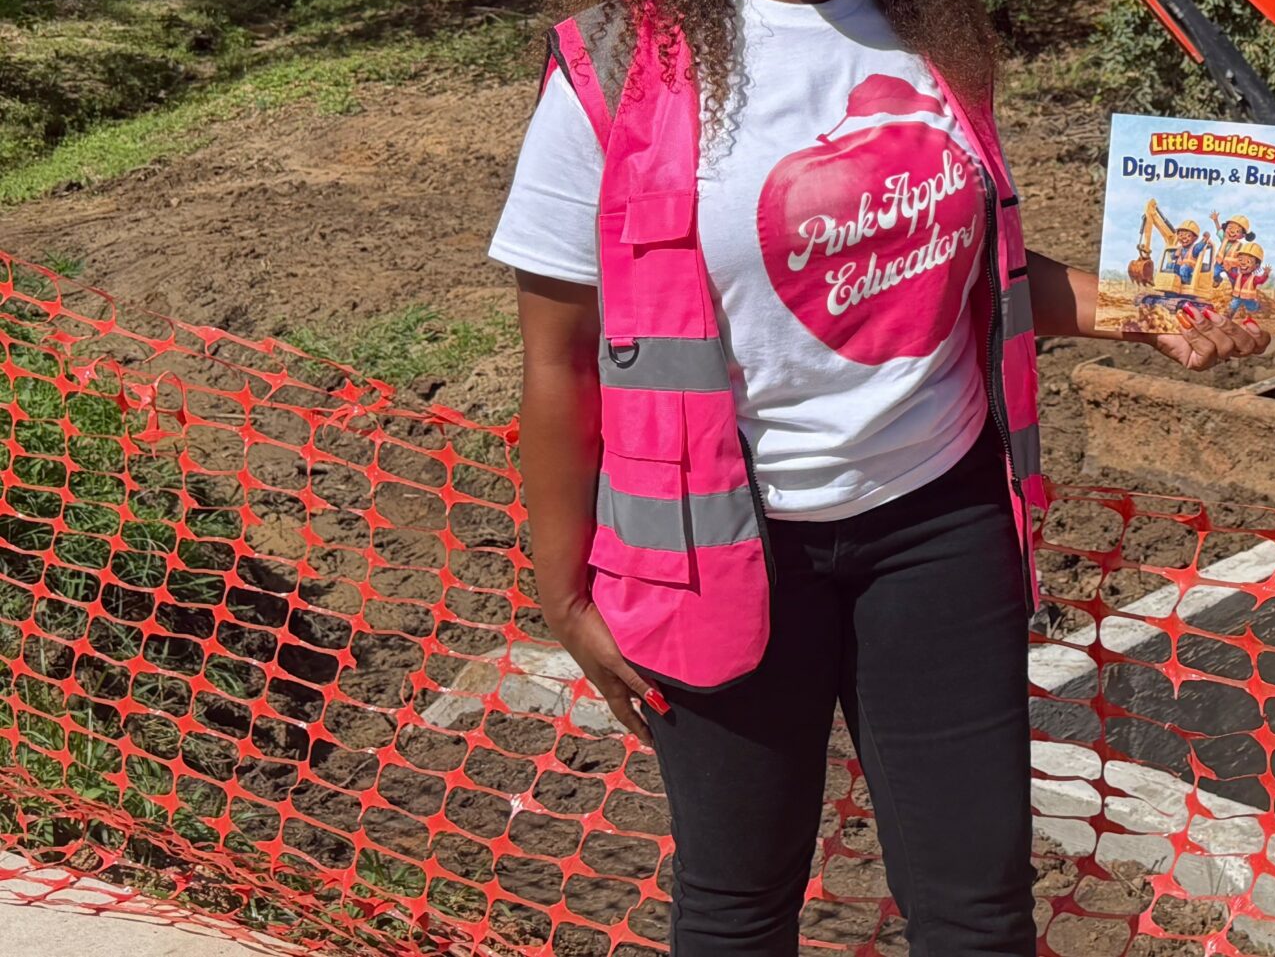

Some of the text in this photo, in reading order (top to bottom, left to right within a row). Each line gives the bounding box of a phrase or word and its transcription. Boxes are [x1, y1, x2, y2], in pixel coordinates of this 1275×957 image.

[1122, 156, 1160, 182] Dig,
[1163, 157, 1225, 185] Dump,
[1228, 168, 1241, 183] &
[1152, 132, 1275, 160] Little Builders
[787, 149, 966, 272] Pink Apple
[825, 214, 977, 316] Educators
